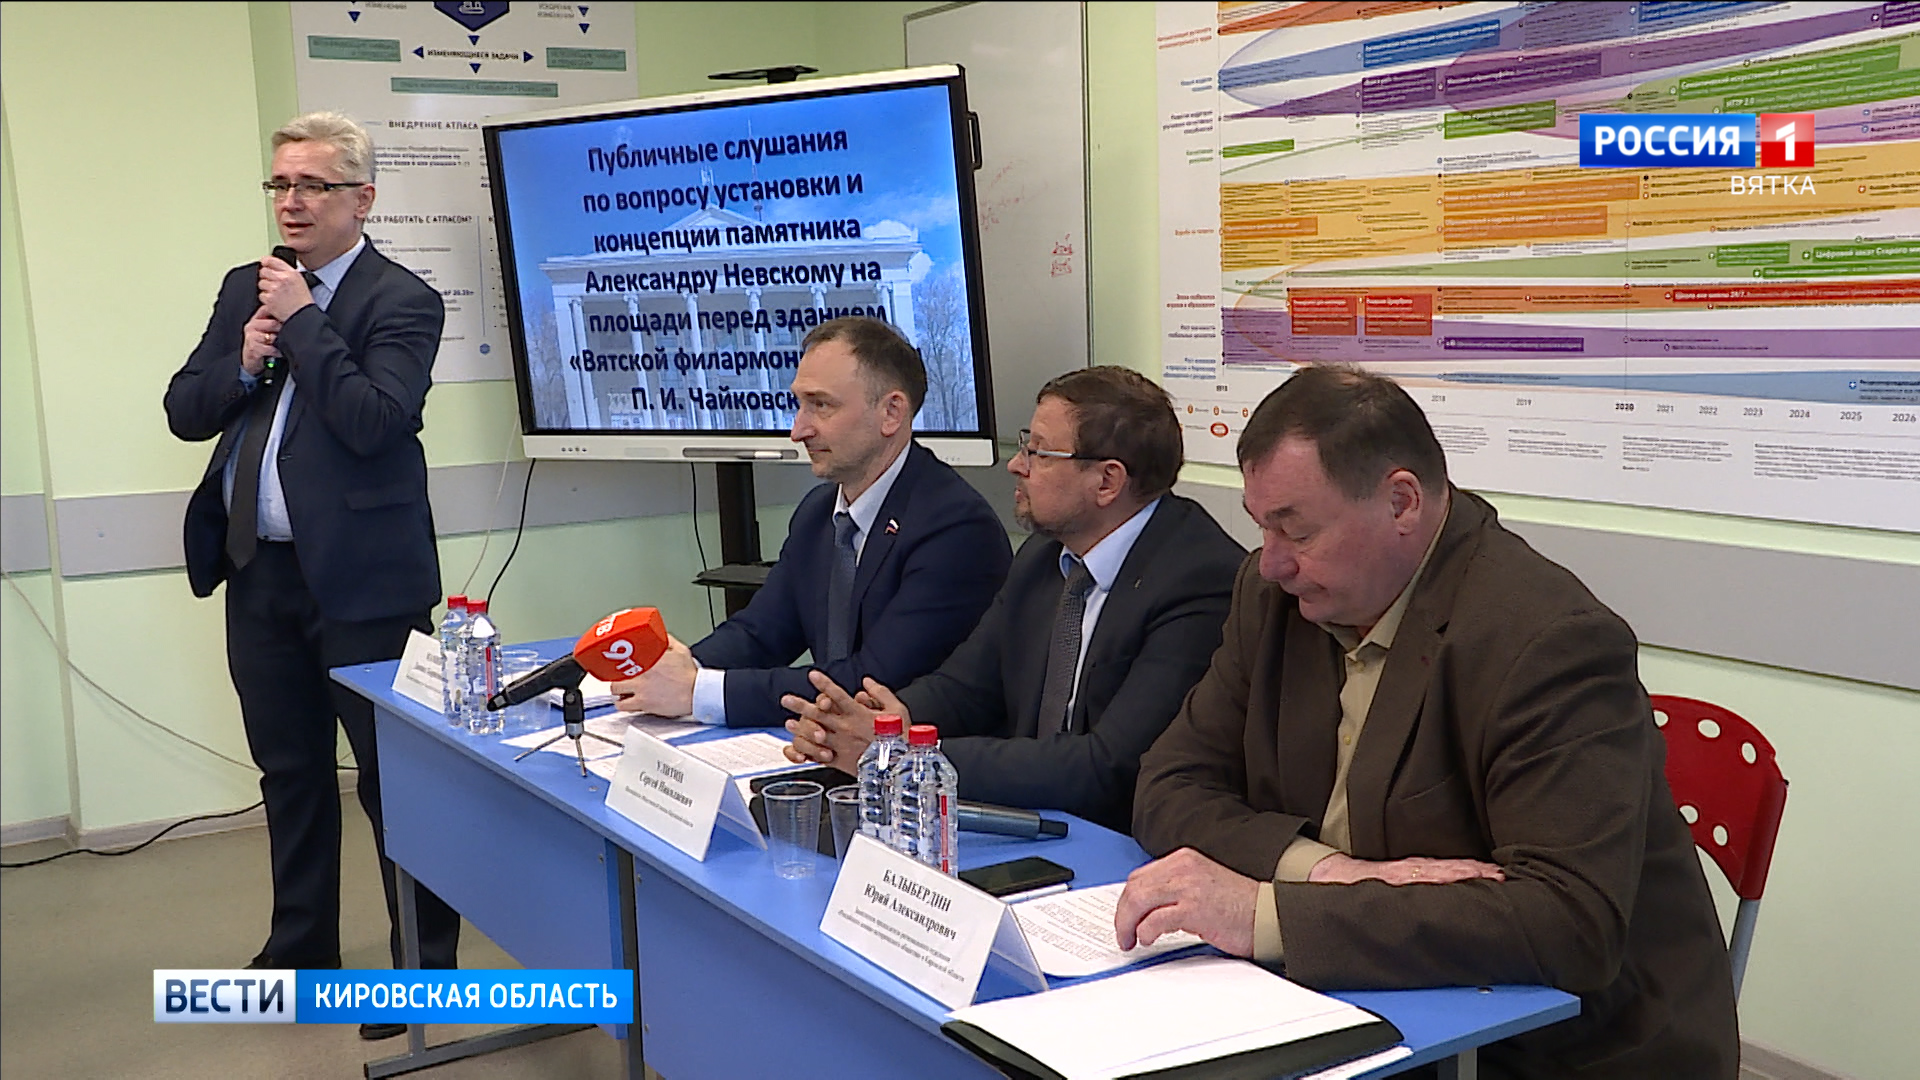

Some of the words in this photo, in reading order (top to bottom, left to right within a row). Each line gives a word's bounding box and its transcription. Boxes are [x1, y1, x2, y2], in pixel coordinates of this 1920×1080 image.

[389, 121, 442, 130] ВНЕДРЕНИЕ
[446, 121, 479, 130] АТЛАСА
[588, 142, 719, 177] Публичные
[724, 129, 848, 164] слушания
[584, 193, 611, 214] по
[616, 185, 709, 214] вопросу
[714, 175, 840, 203] установки
[846, 173, 864, 195] и
[384, 215, 424, 224] РАБОТАТЬ
[426, 215, 431, 224] С
[433, 215, 472, 224] АТЛАСОМ?
[594, 227, 721, 256] концепции
[725, 217, 861, 246] памятника
[585, 269, 718, 295] Александру
[723, 262, 845, 290] Невскому
[850, 261, 882, 282] на
[589, 311, 692, 338] площади
[697, 308, 772, 335] перед
[569, 346, 668, 373] «Вятской
[674, 348, 804, 376] филармон
[631, 387, 652, 410] П.
[659, 387, 685, 410] И.
[688, 386, 800, 411] Чайковск
[1656, 404, 1674, 413] 2021
[1699, 405, 1718, 415] 2022
[1743, 406, 1763, 417] 2023
[1789, 408, 1811, 419] 2024
[1840, 410, 1863, 422] 2025
[1892, 412, 1917, 424] 2026
[883, 869, 952, 912] БАЛЫБЕРДИН
[864, 883, 891, 906] Юрий
[890, 897, 957, 940] Александрович
